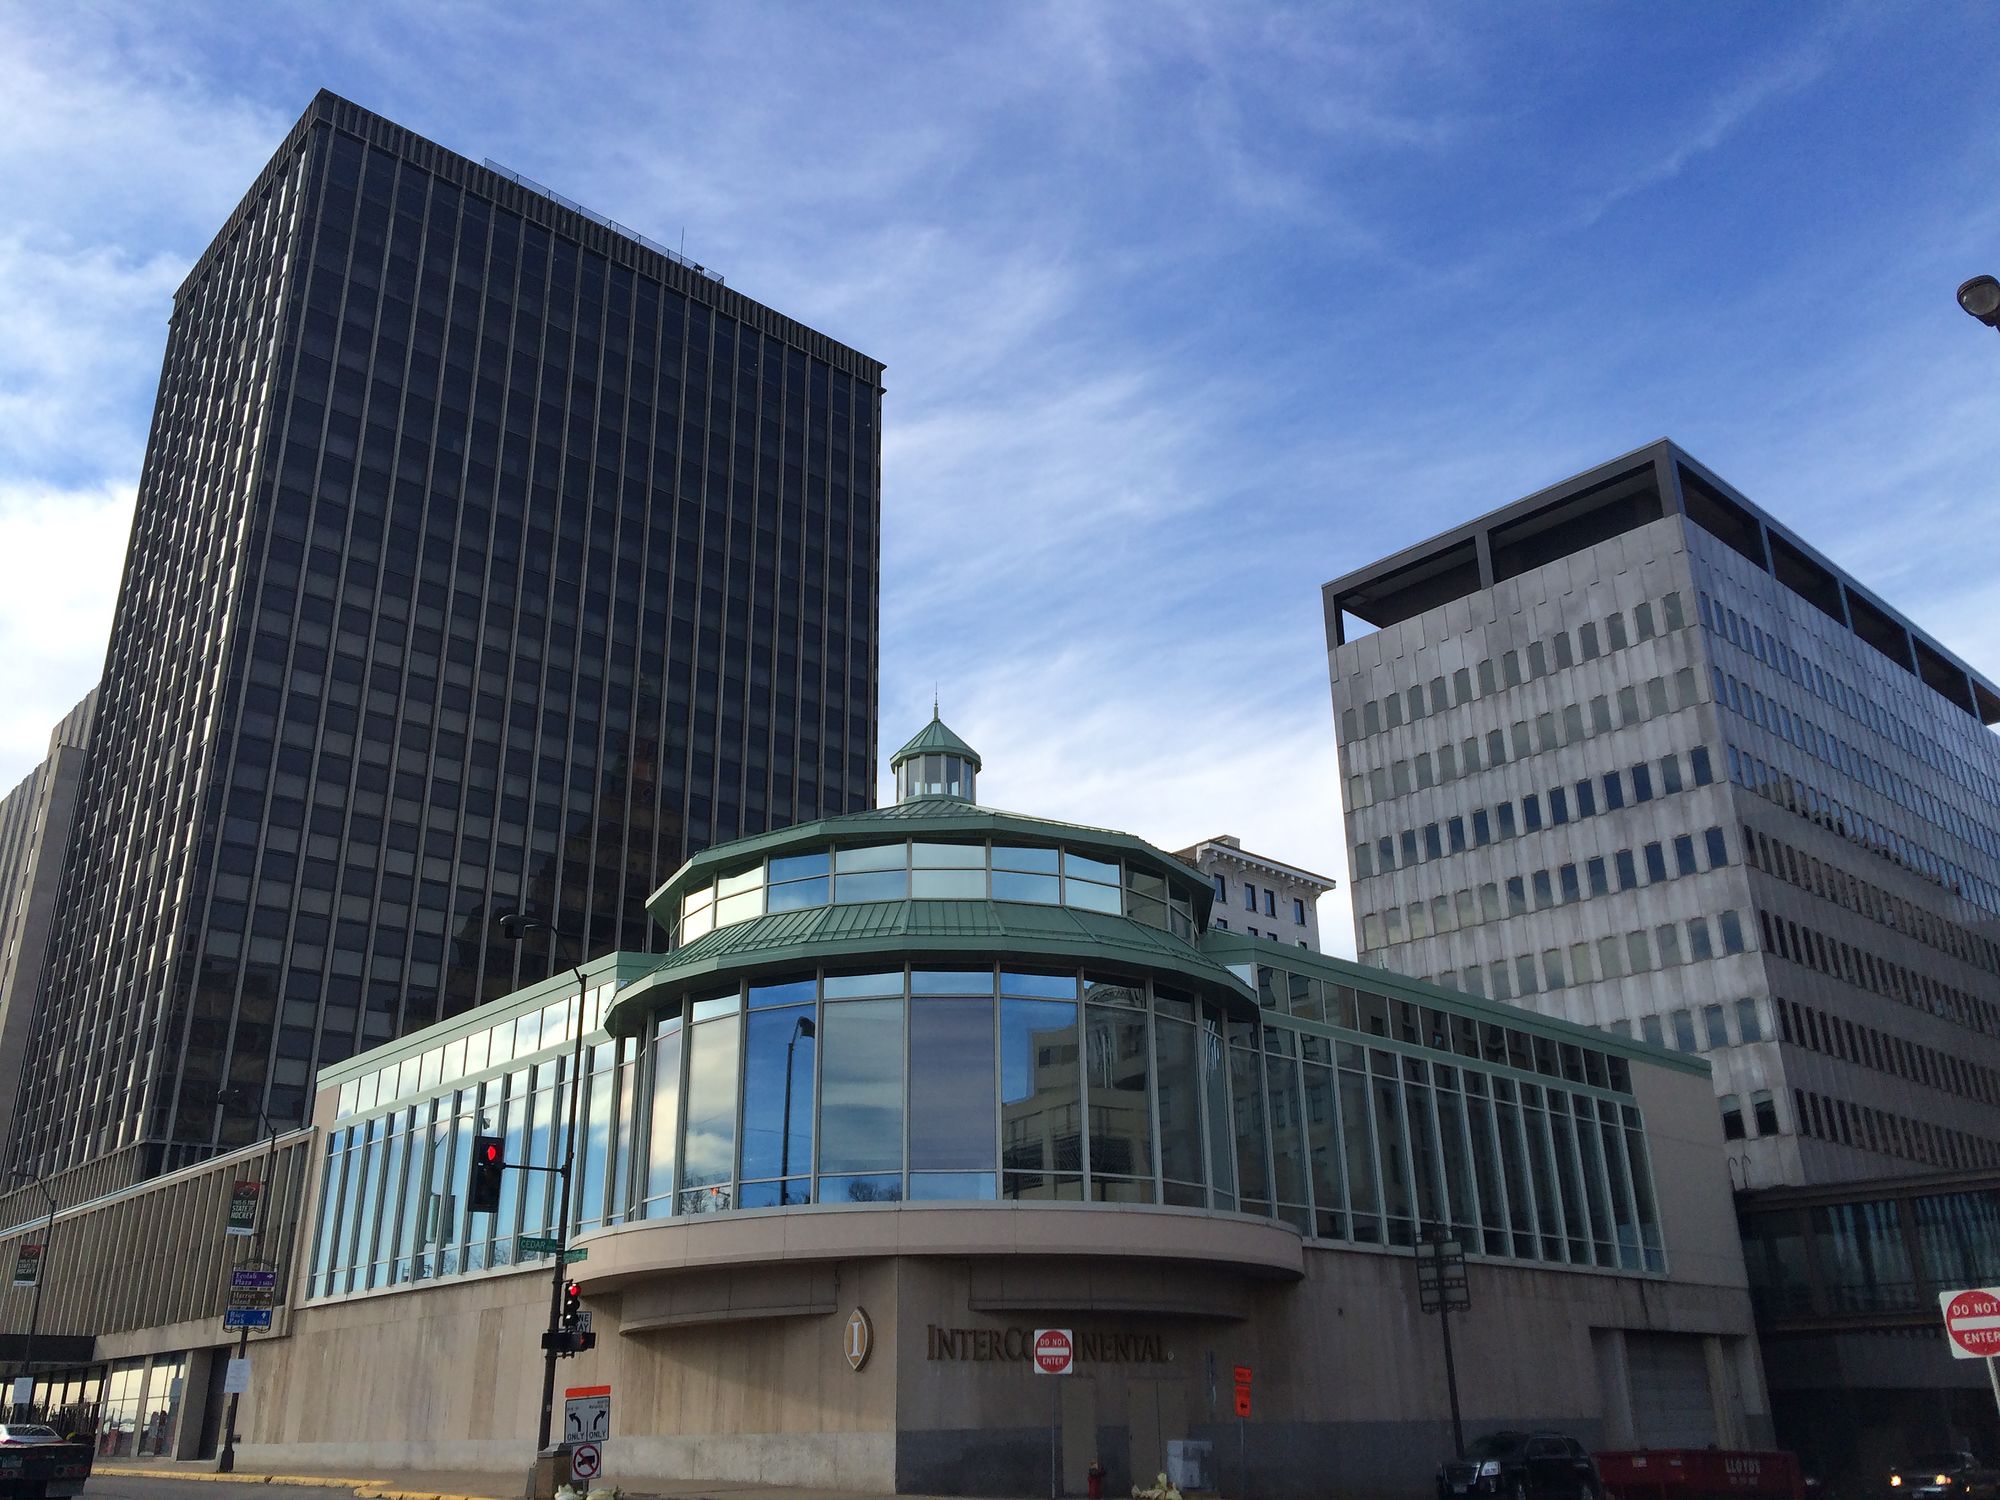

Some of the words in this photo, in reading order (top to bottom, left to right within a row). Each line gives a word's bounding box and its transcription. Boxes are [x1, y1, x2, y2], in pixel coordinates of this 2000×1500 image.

[521, 1240, 546, 1250] CEDAR
[1953, 1304, 1969, 1316] DO
[1974, 1302, 1998, 1314] NOT
[1040, 1338, 1050, 1346] DO
[1052, 1338, 1067, 1346] NOT
[1964, 1331, 2000, 1344] ENTER
[927, 1324, 1168, 1363] INTERCONENTAL
[1043, 1357, 1064, 1365] ENTER
[567, 1432, 585, 1441] ONLY
[589, 1430, 606, 1439] ONLY
